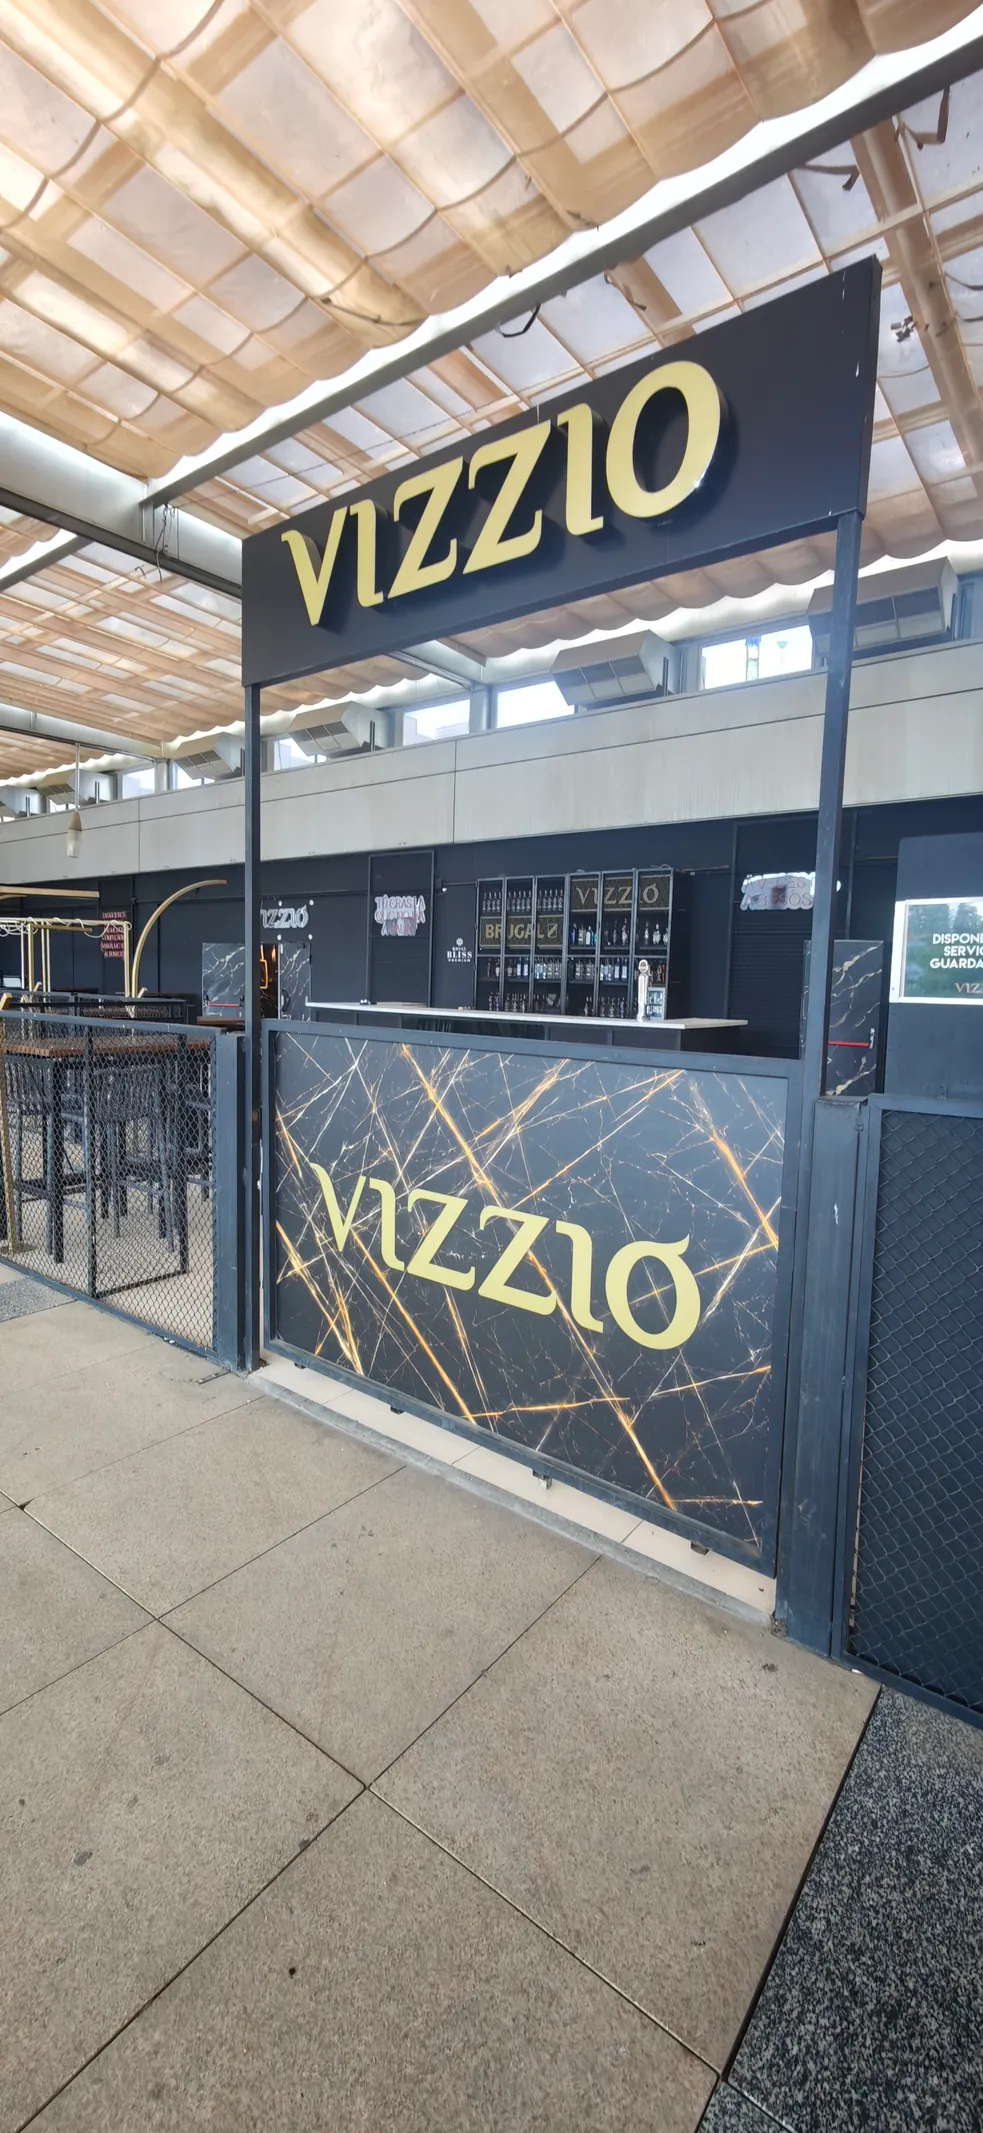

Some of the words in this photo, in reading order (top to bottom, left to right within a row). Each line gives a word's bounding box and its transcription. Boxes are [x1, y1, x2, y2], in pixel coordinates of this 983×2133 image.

[282, 360, 722, 626] VIZZIO
[389, 896, 413, 910] ERAS
[576, 882, 660, 905] VIZZO
[260, 904, 309, 929] IZZIO
[447, 950, 472, 959] BLISS
[954, 982, 983, 994] VIZ
[310, 1163, 702, 1350] VIZZIO
